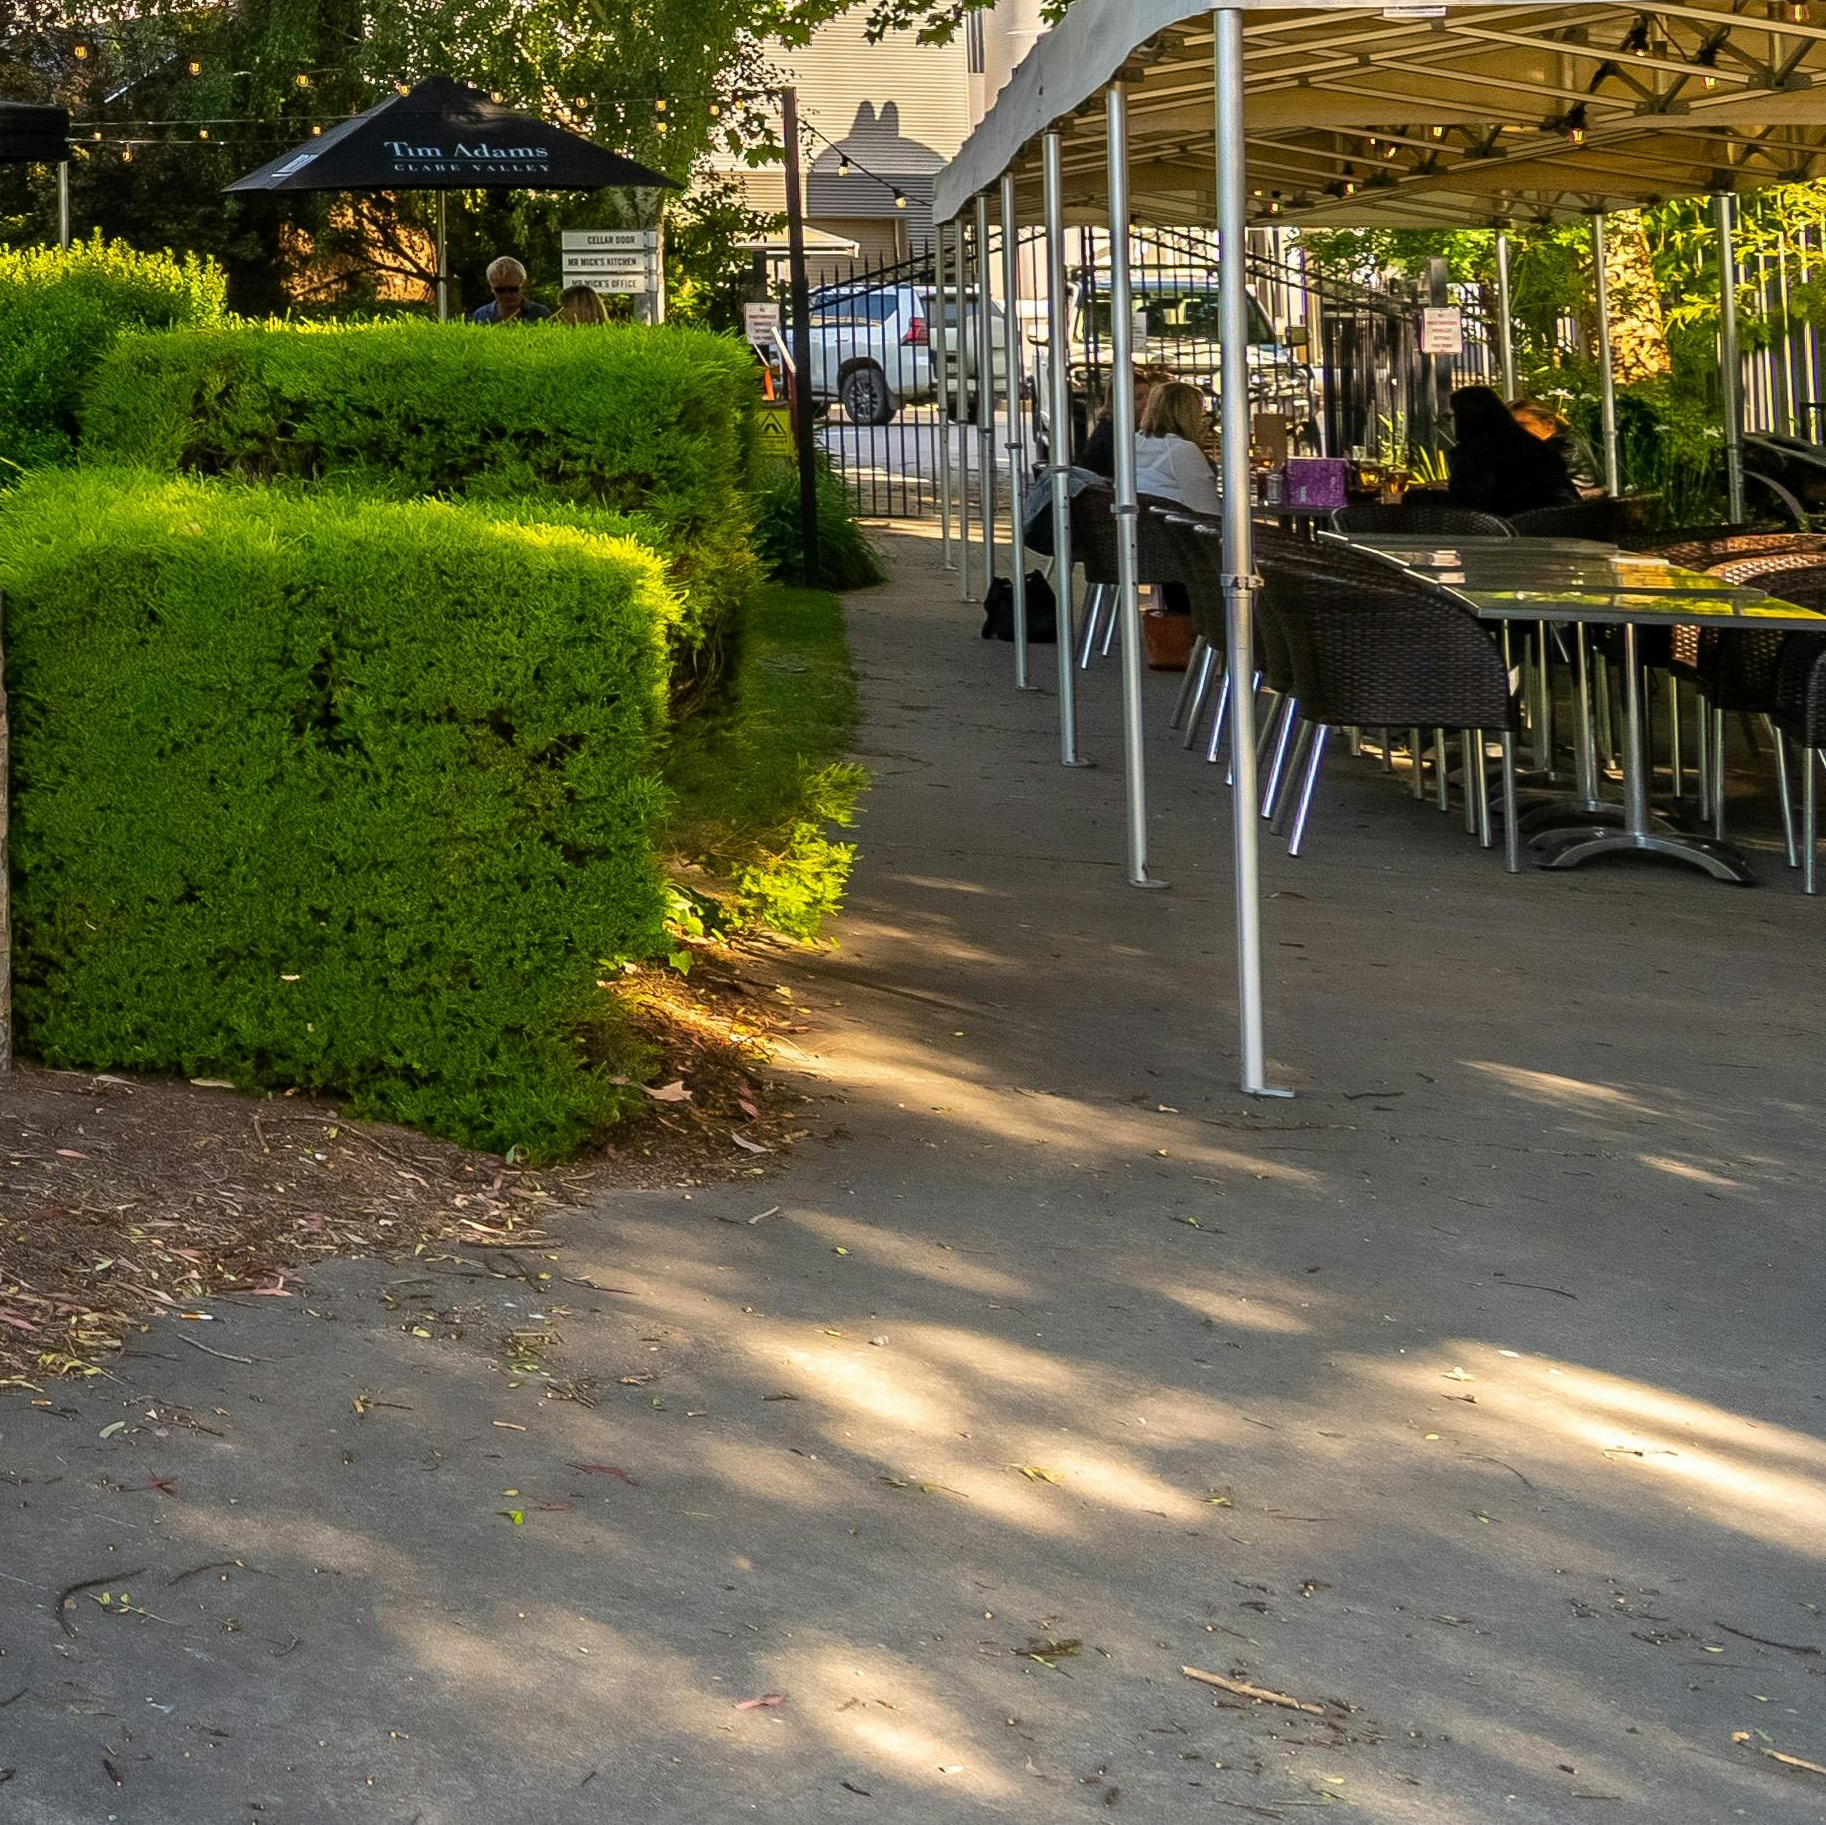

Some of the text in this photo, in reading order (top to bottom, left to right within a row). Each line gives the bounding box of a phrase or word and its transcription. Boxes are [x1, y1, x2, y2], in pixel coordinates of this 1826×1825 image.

[383, 141, 549, 158] Tim Adams
[393, 163, 550, 172] CLARE VALLEY
[587, 235, 636, 245] CELLAR DOOR
[567, 257, 637, 266] MR MICK'S KITCHEN
[611, 279, 637, 288] OFFICE
